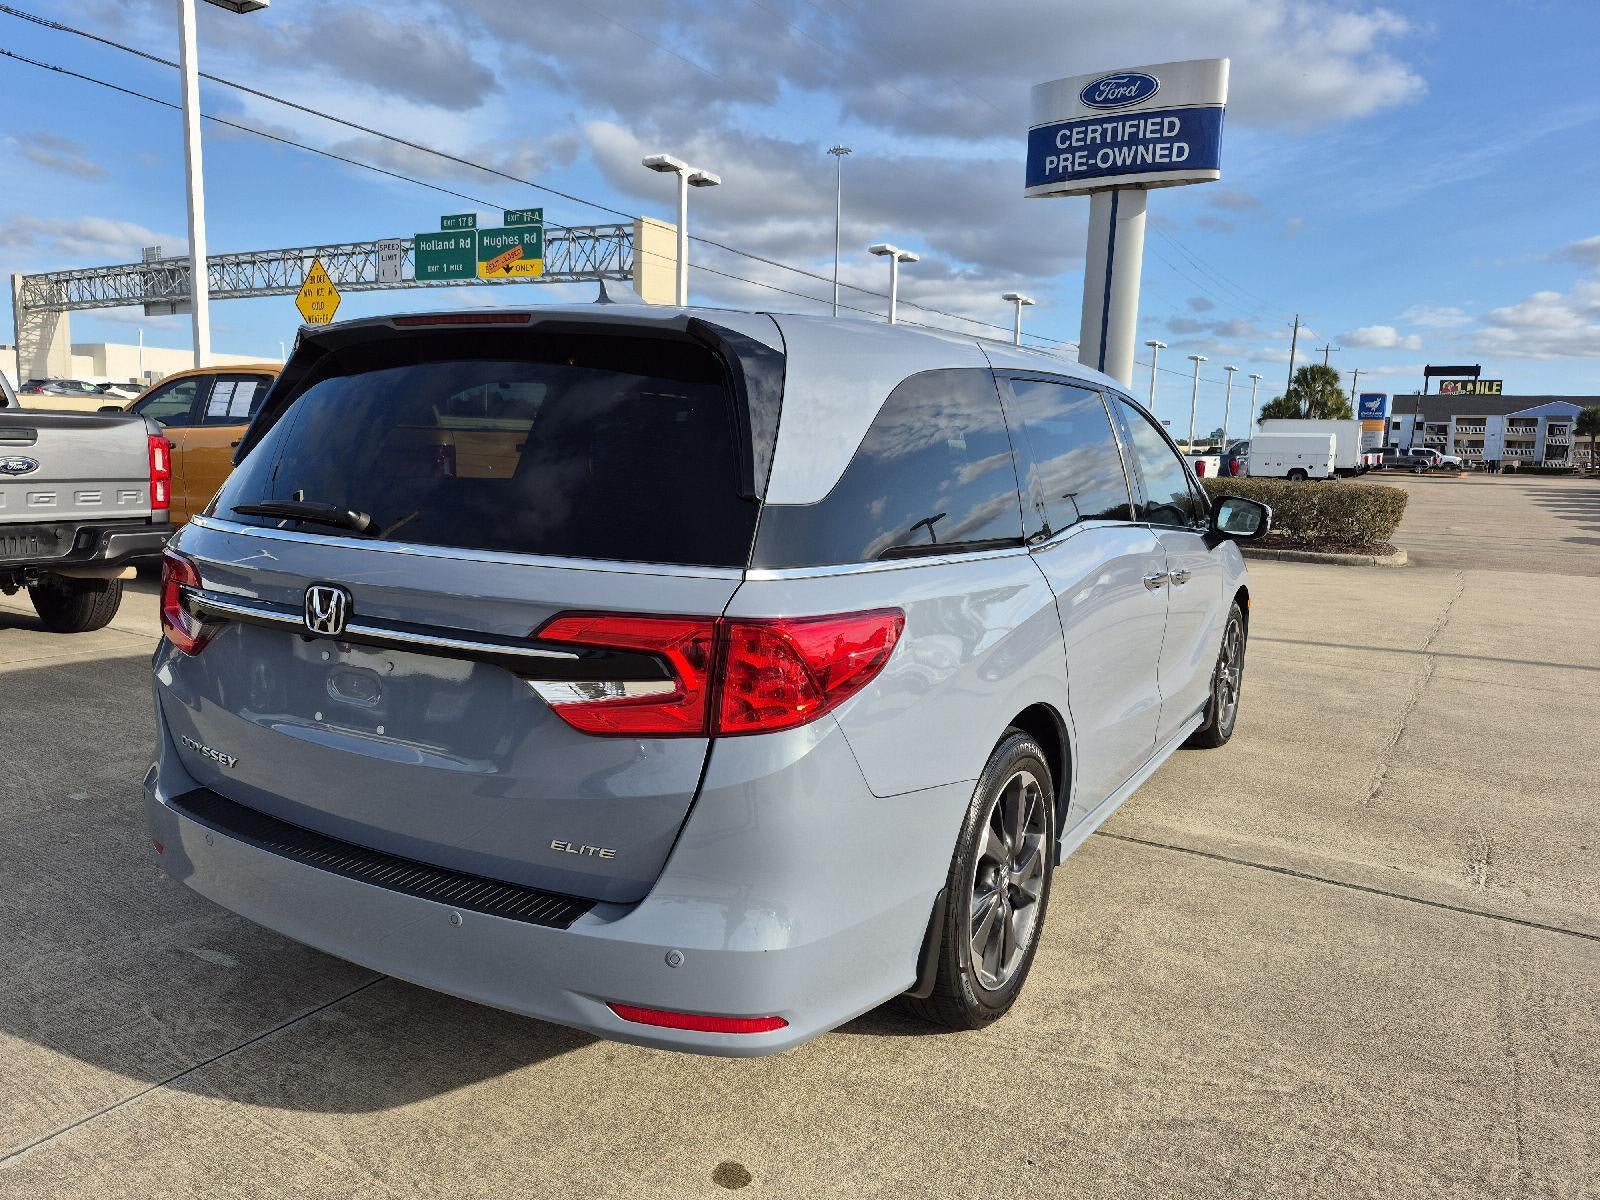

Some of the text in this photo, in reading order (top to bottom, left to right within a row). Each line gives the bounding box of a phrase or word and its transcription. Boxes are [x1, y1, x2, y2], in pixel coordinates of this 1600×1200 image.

[1094, 77, 1140, 102] Ford
[1055, 116, 1181, 150] CERTIFIED
[1044, 142, 1190, 176] PRE-OWNED
[443, 219, 456, 227] EXIT
[507, 214, 519, 222] EXIT
[420, 237, 471, 251] Holland Rd
[483, 232, 537, 248] Hughes Rd
[379, 243, 400, 252] SPEED
[381, 254, 397, 262] LIMIT
[427, 265, 439, 273] EXIT
[515, 263, 535, 272] ONLY
[181, 734, 239, 768] ODYSSEY
[550, 839, 617, 859] ELITE
